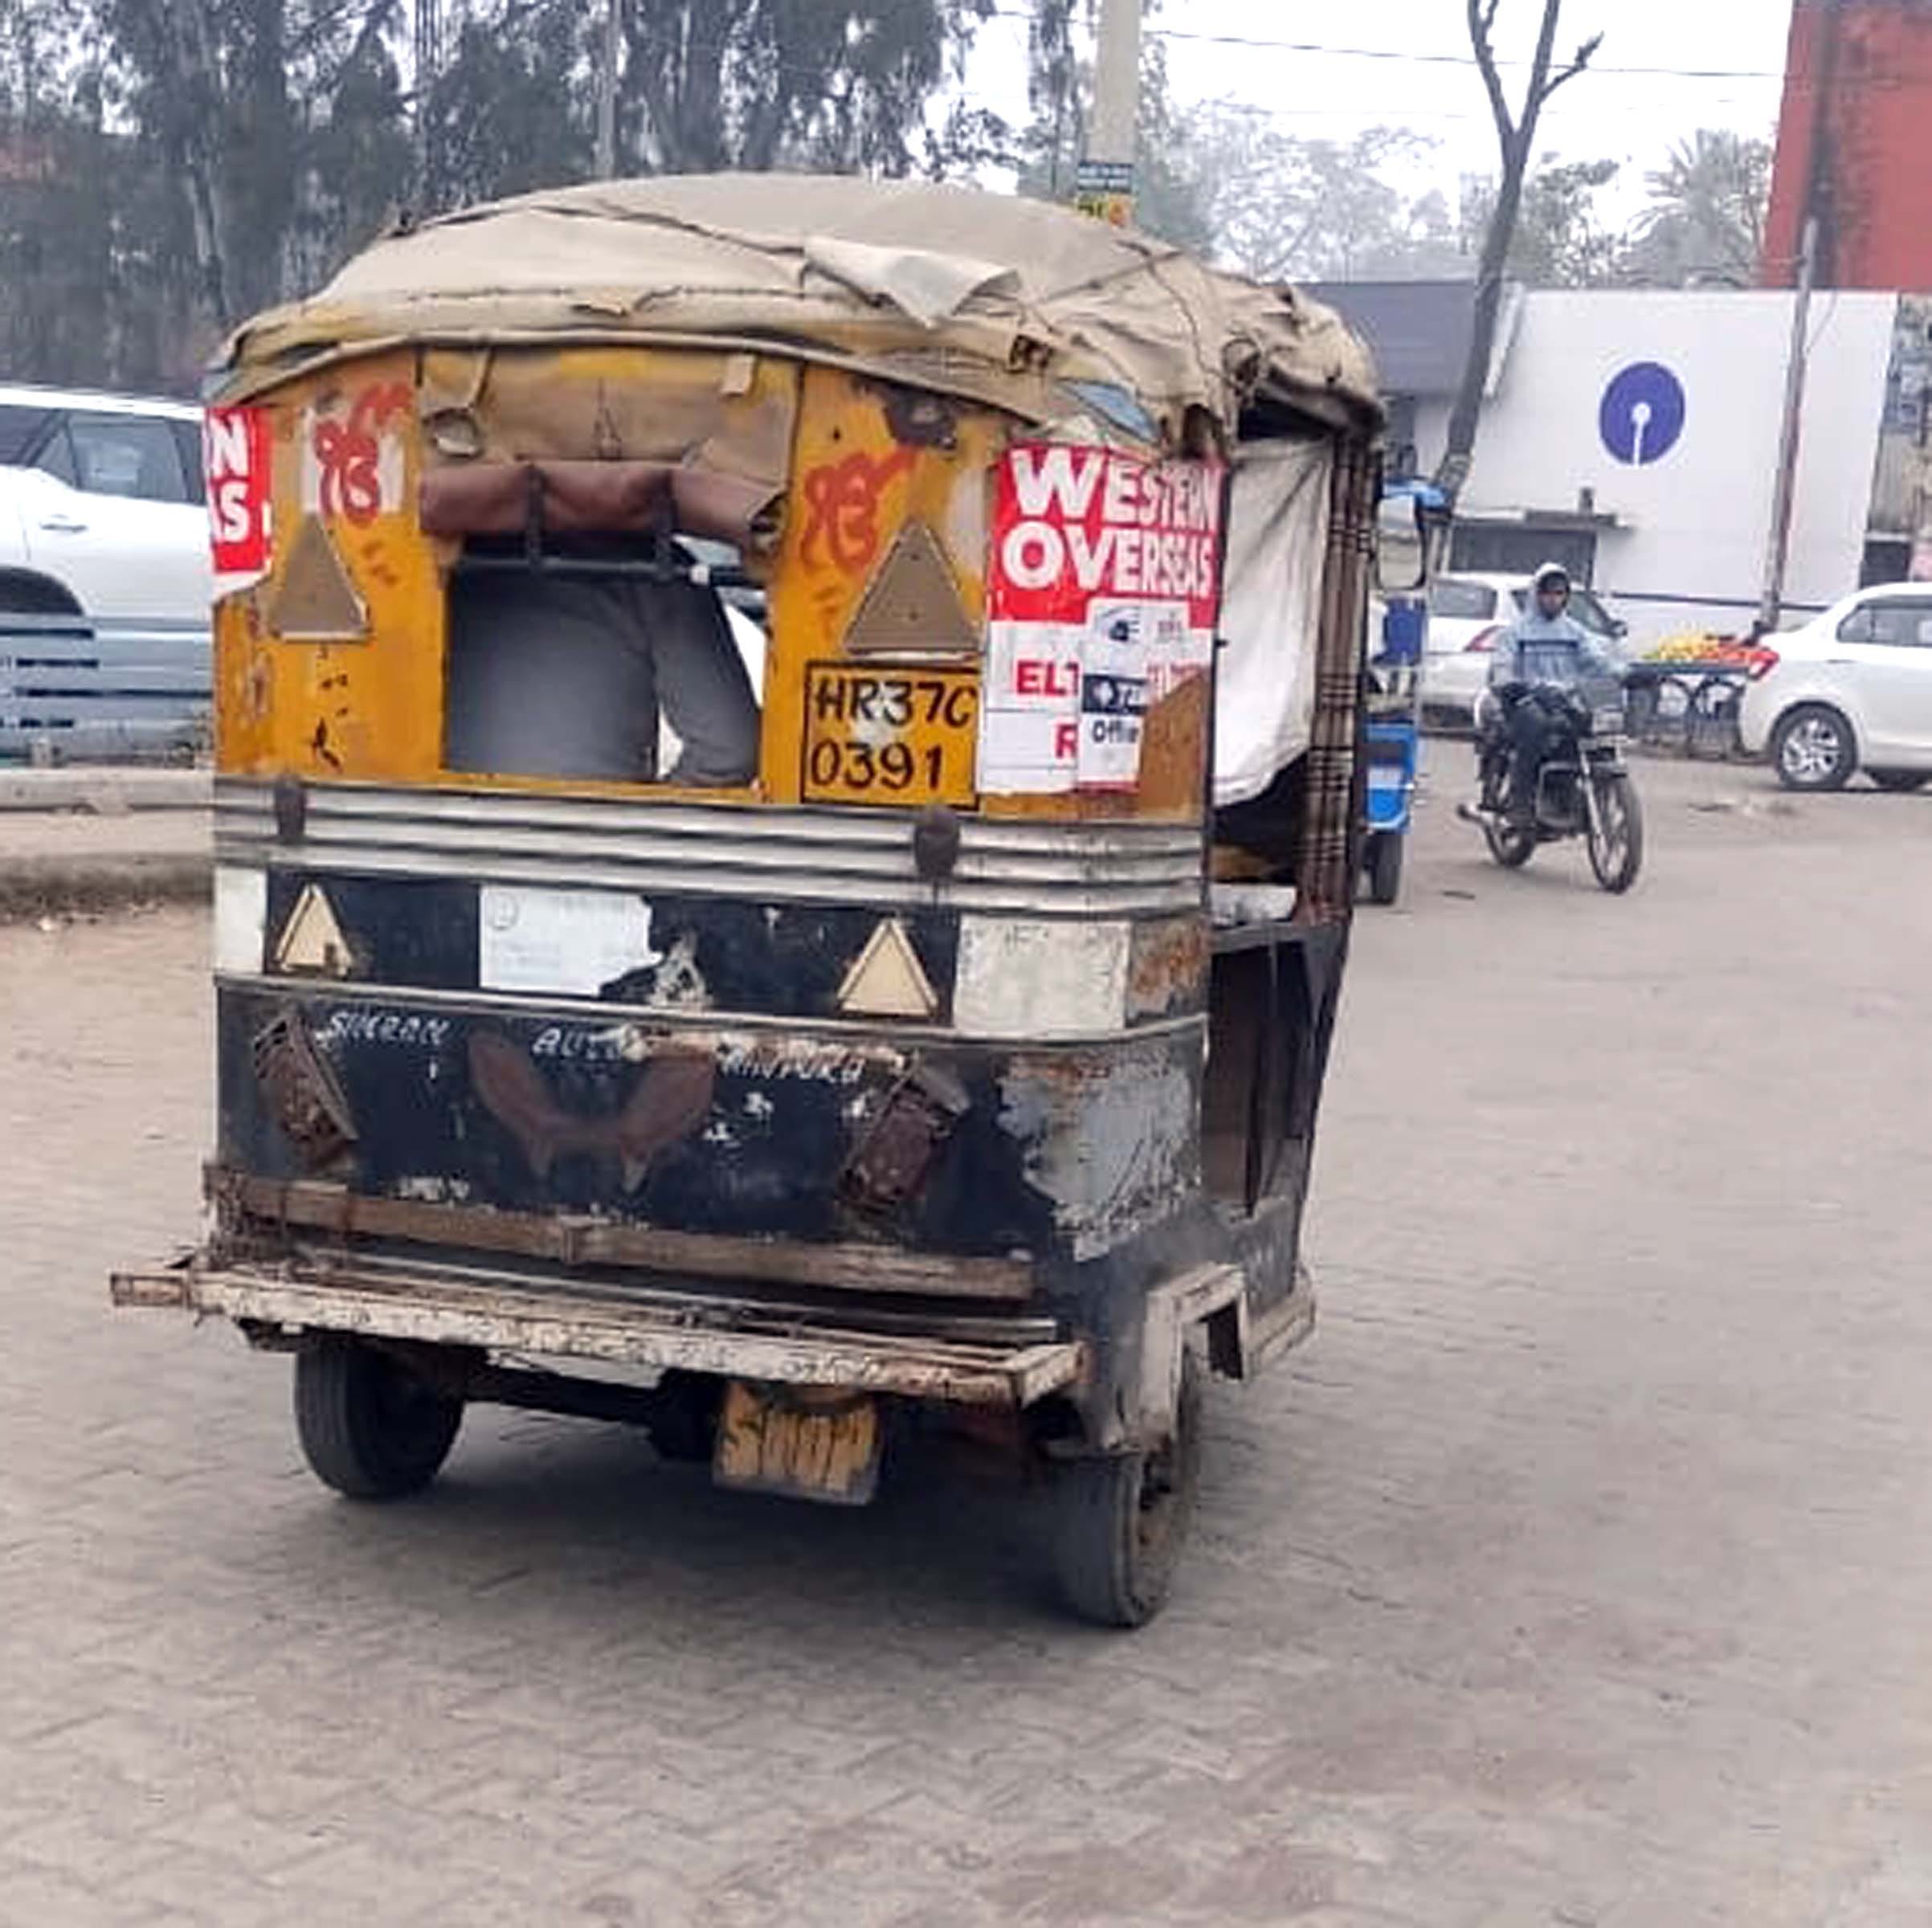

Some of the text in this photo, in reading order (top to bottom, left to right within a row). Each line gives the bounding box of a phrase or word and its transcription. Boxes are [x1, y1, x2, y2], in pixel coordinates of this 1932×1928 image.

[1009, 447, 1223, 533] WESTERN
[815, 676, 978, 728] HR37C
[810, 737, 943, 790] 0391
